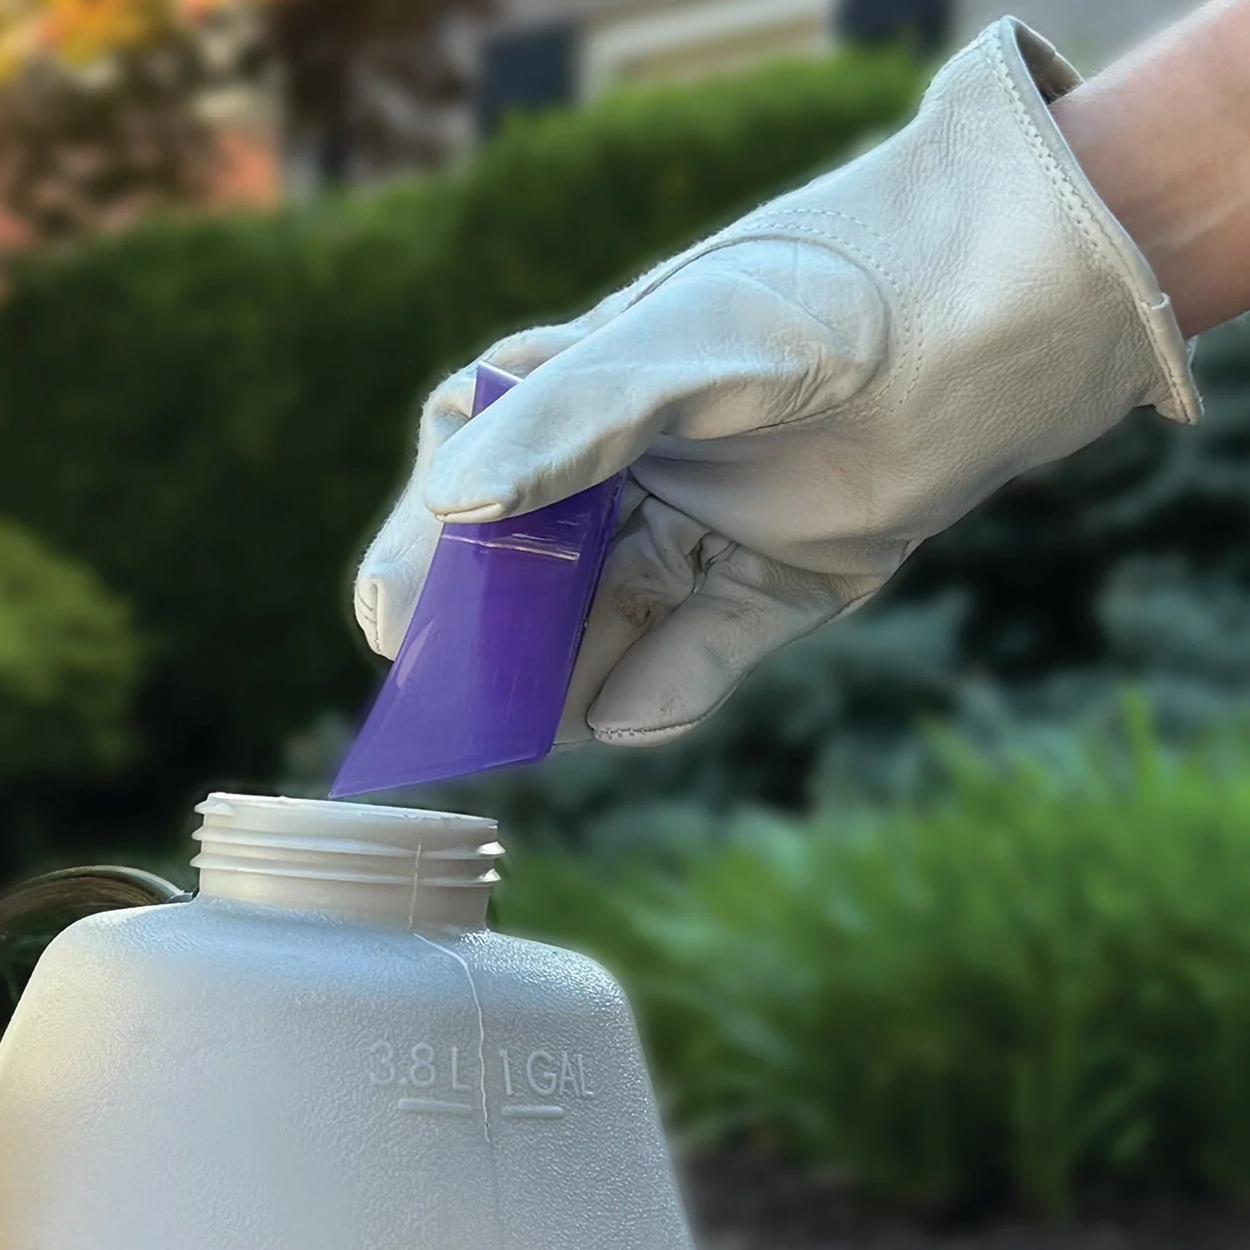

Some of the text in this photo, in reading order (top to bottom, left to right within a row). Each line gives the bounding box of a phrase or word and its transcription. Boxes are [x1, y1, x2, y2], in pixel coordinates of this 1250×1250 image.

[370, 1040, 472, 1091] 3.8 L
[500, 1049, 596, 1096] 1 GAL
